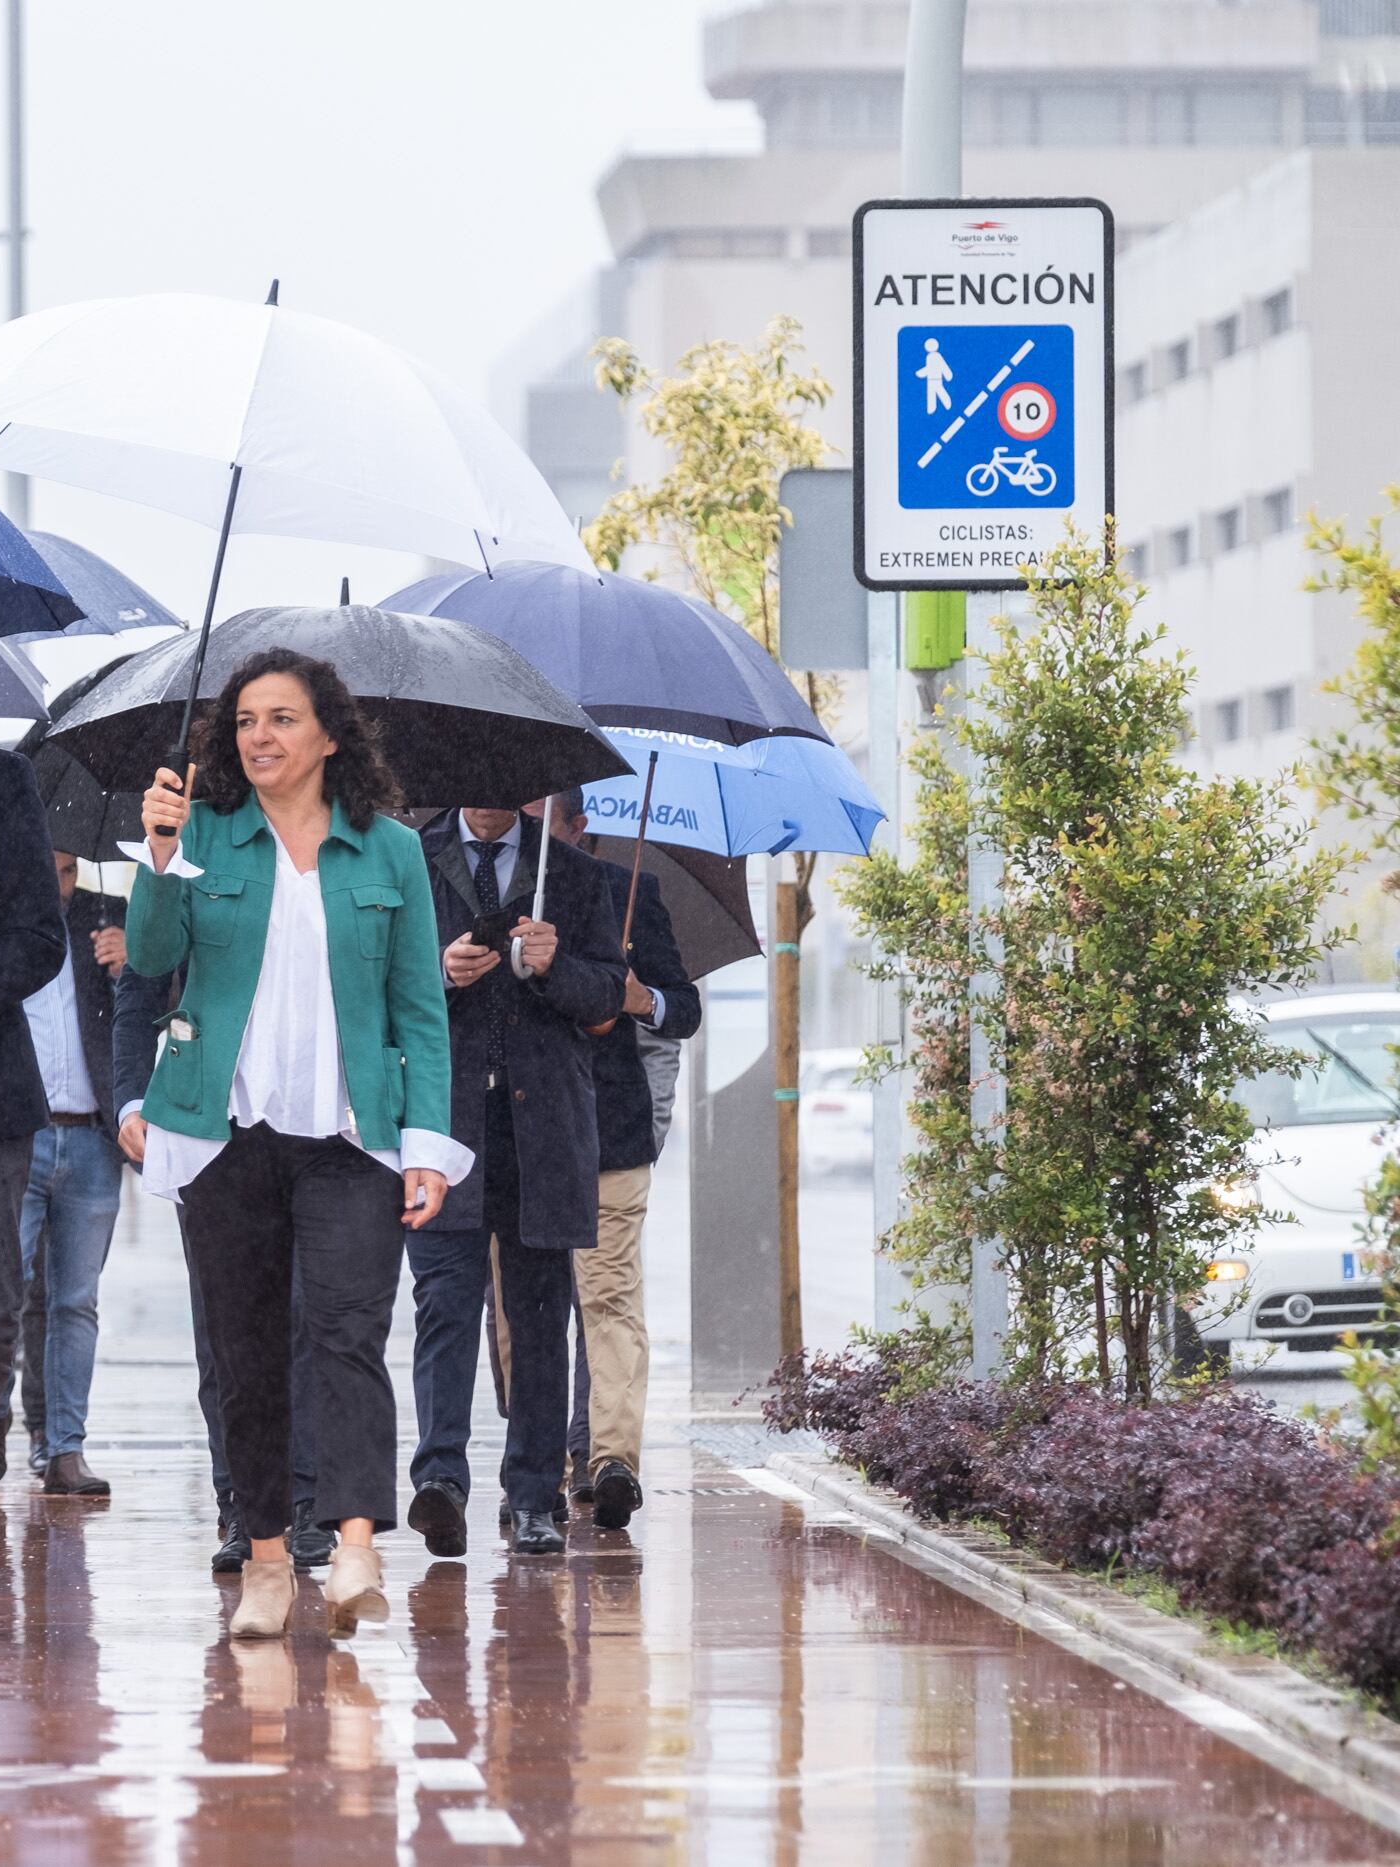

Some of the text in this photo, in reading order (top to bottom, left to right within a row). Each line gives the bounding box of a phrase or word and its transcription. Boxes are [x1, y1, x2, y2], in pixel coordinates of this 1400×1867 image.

[952, 233, 1019, 243] Puerto de Vigo
[874, 264, 1095, 306] ATENCIÓN
[1013, 402, 1041, 420] 10
[939, 525, 1034, 541] CICLISTAS:
[880, 551, 1045, 568] EXTREMEN PRECA
